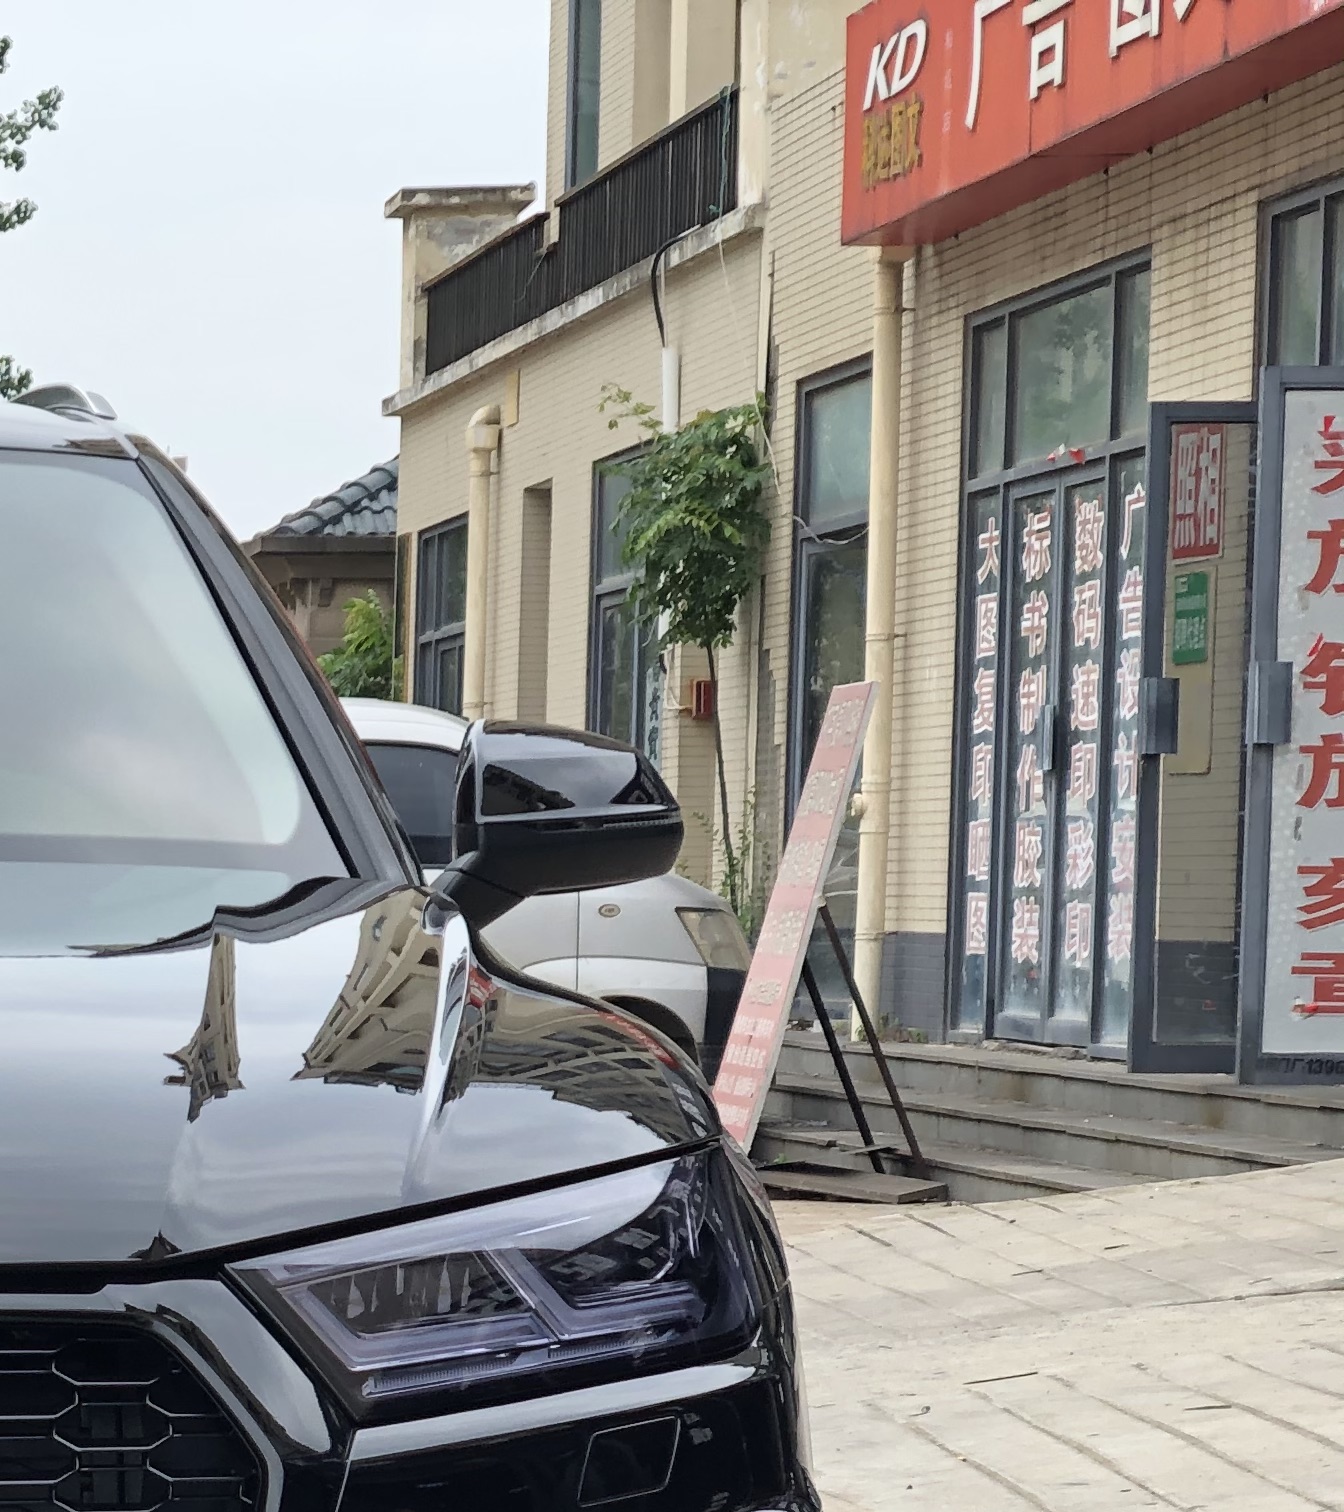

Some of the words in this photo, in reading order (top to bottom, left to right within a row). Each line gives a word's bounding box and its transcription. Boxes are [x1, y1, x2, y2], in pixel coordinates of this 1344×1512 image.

[862, 18, 927, 112] KD
[1173, 427, 1221, 549] 照相
[1064, 496, 1105, 968] 数码速印彩印
